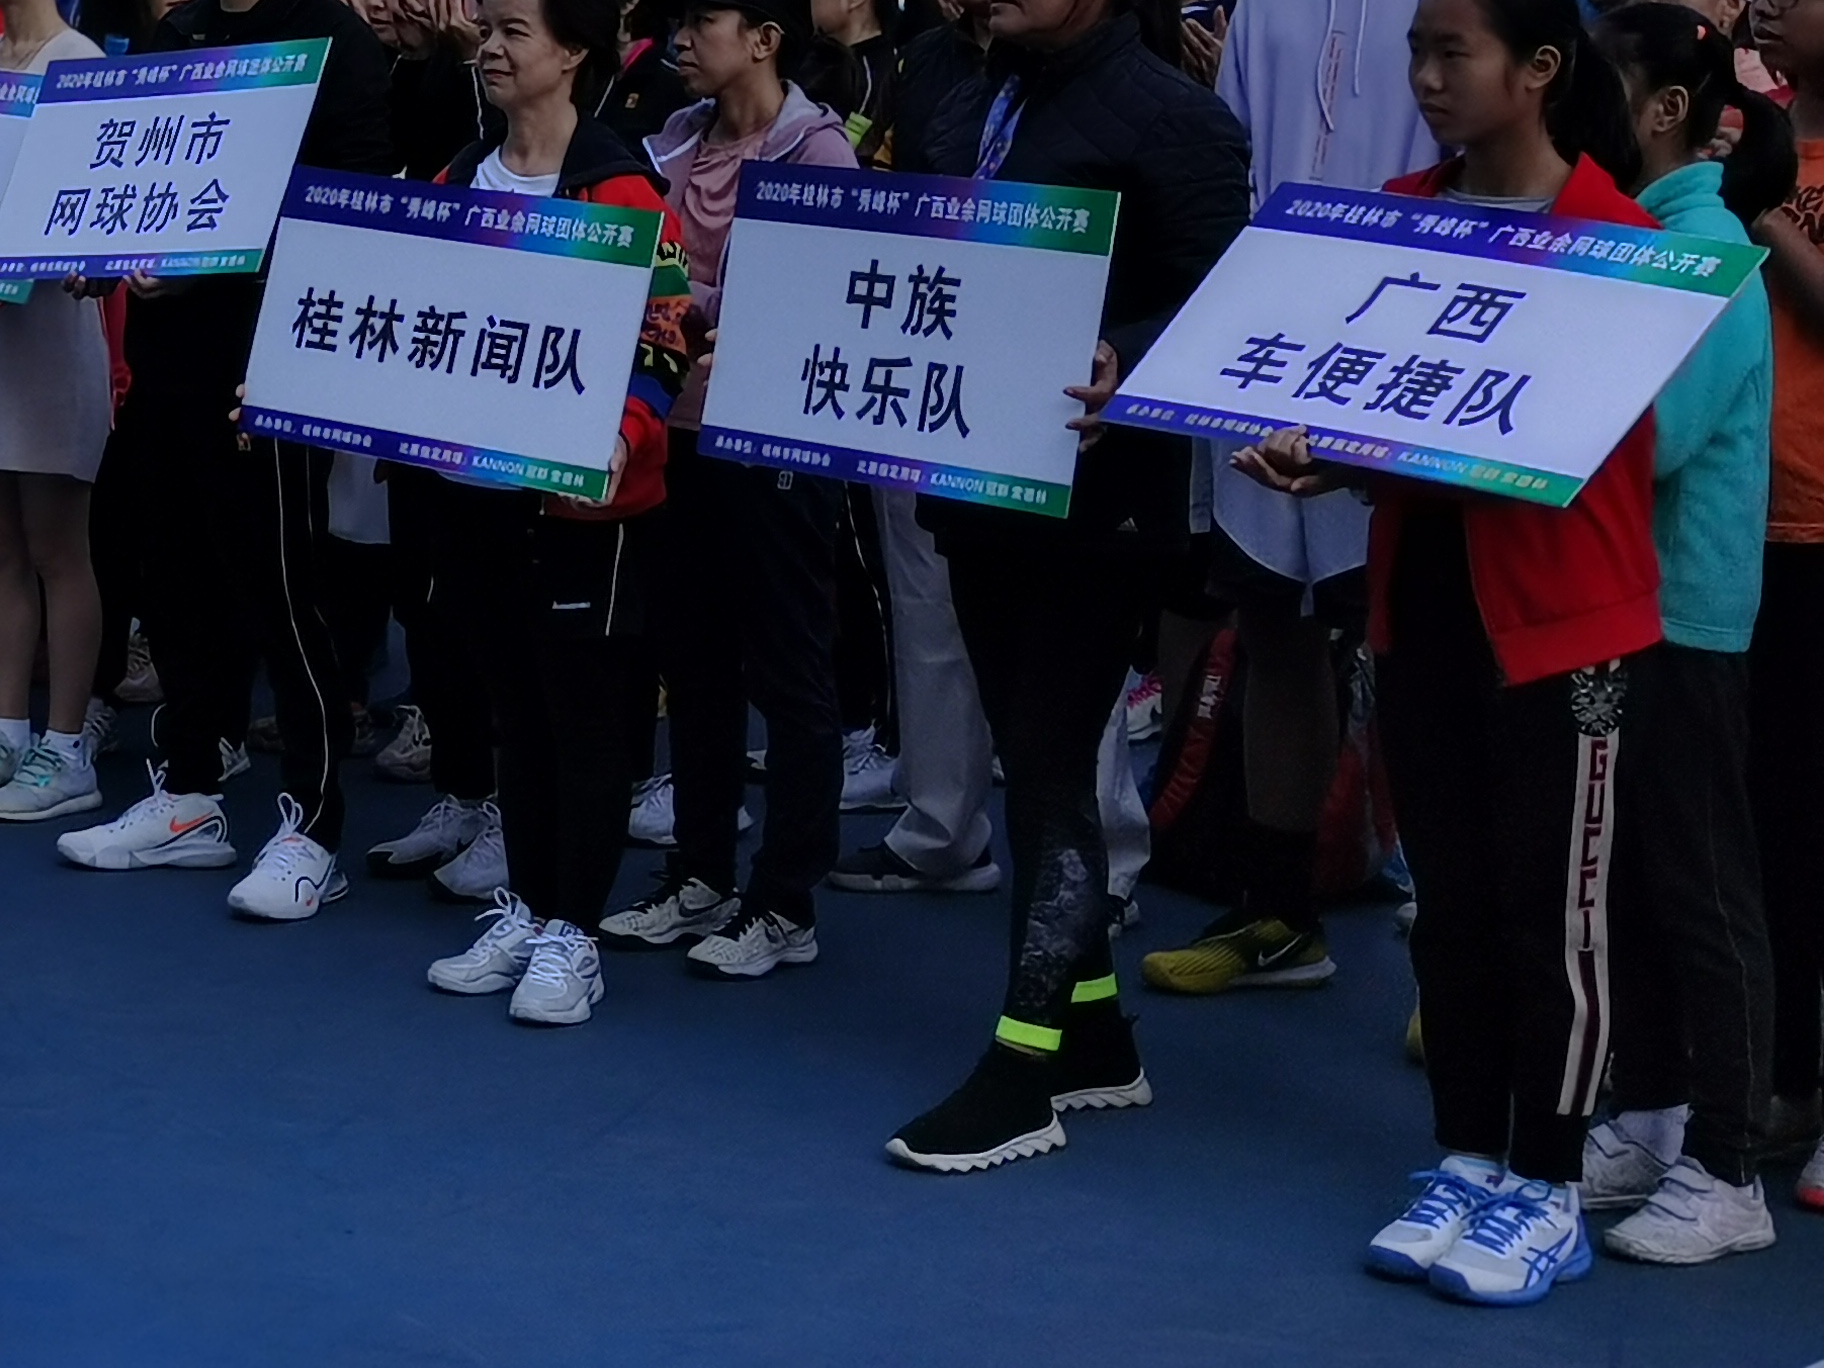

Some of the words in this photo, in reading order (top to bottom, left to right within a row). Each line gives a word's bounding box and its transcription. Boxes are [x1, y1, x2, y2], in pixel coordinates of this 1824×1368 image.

[89, 111, 231, 170] 贺州市
[44, 178, 229, 235] 网球协会
[291, 287, 586, 396] 桂林新闻队
[845, 259, 962, 341] 中族
[1344, 271, 1527, 344] 广西
[801, 343, 971, 439] 快乐队
[1219, 331, 1534, 436] 车便捷队
[1578, 738, 1608, 949] GUCCI
